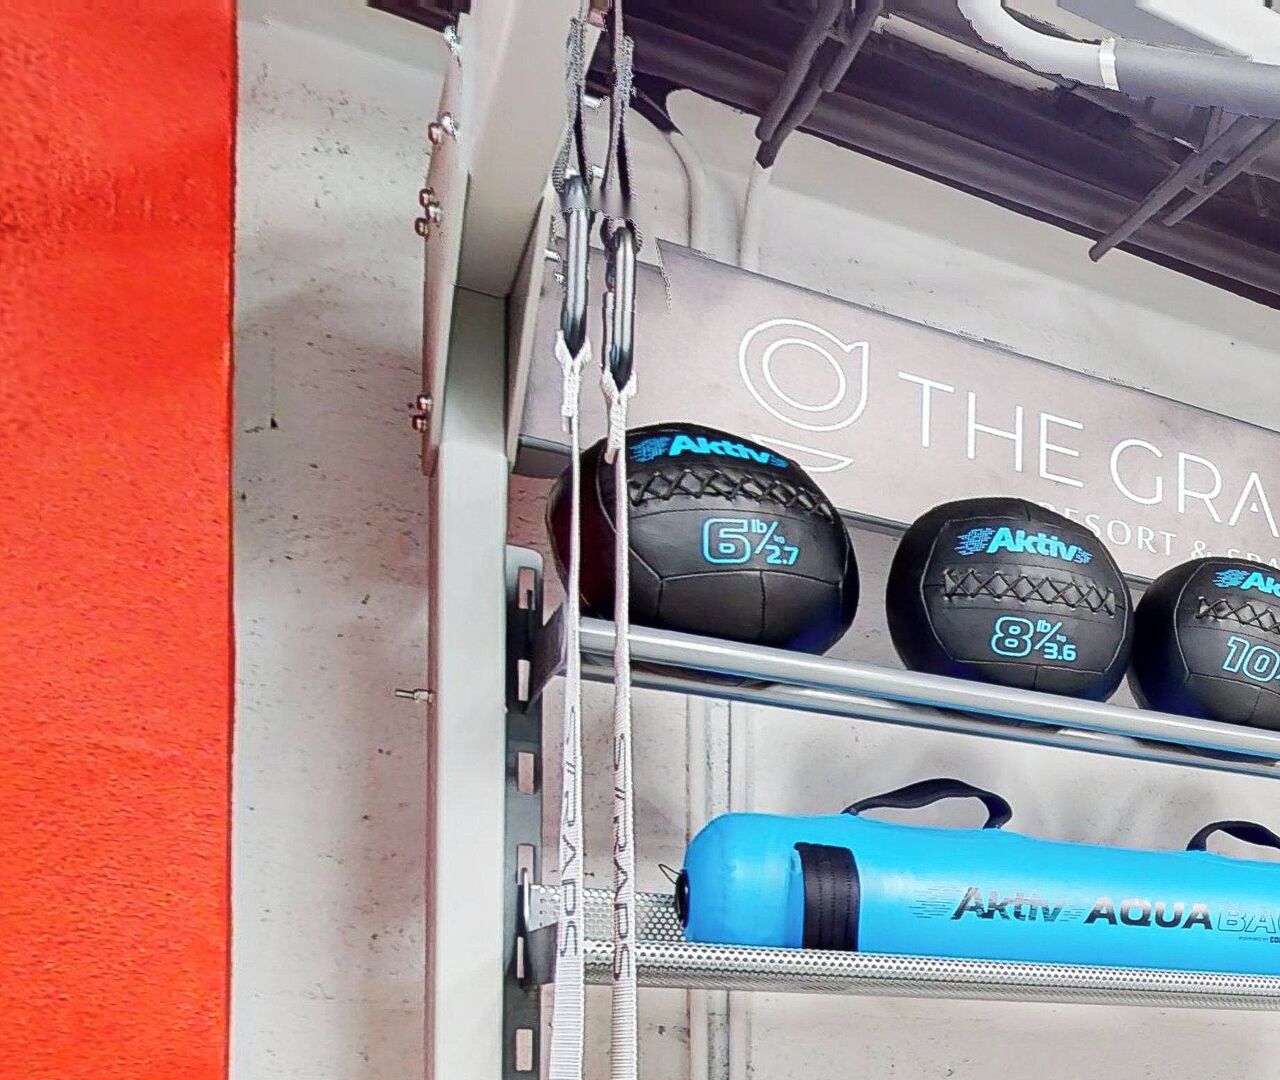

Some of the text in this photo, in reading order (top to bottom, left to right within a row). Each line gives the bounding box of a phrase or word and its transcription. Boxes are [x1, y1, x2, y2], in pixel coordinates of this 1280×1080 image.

[668, 435, 770, 464] Aktiv
[898, 371, 1085, 489] THE
[986, 527, 1077, 562] Aktiv
[951, 886, 1066, 923] Aktiv
[1084, 896, 1213, 931] AQUA
